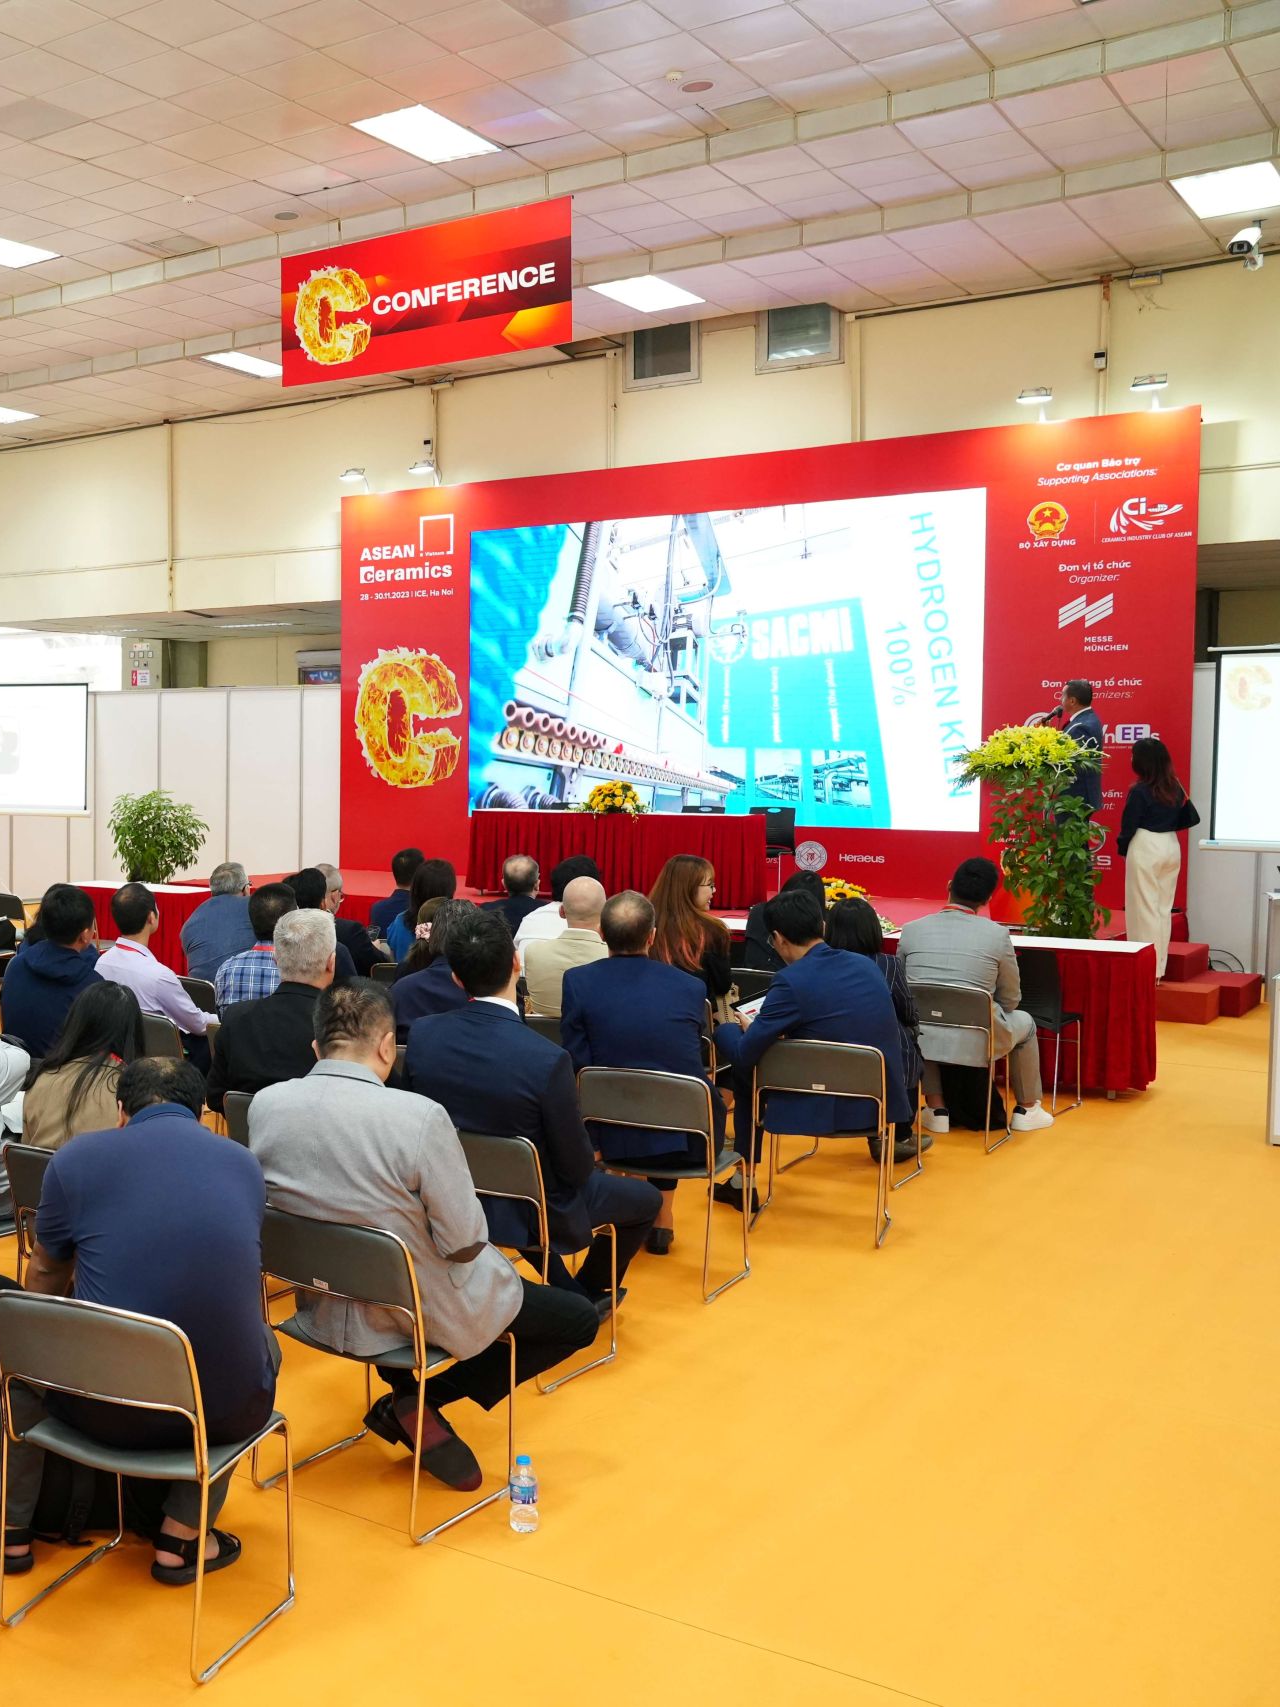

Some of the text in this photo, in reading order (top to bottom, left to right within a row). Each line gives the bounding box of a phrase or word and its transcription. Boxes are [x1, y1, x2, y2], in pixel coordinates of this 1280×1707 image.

[372, 262, 556, 316] CONFERENCE
[1037, 468, 1157, 486] Supporting Associations:
[360, 544, 415, 561] ASEAN
[374, 590, 410, 600] 30.11.2023
[909, 511, 960, 708] HYDROGEN
[751, 606, 854, 661] SACMI
[1084, 635, 1113, 643] MESSE
[1084, 643, 1129, 652] MÜNCHEN
[884, 620, 917, 706] 100%
[839, 853, 885, 864] Heraeus
